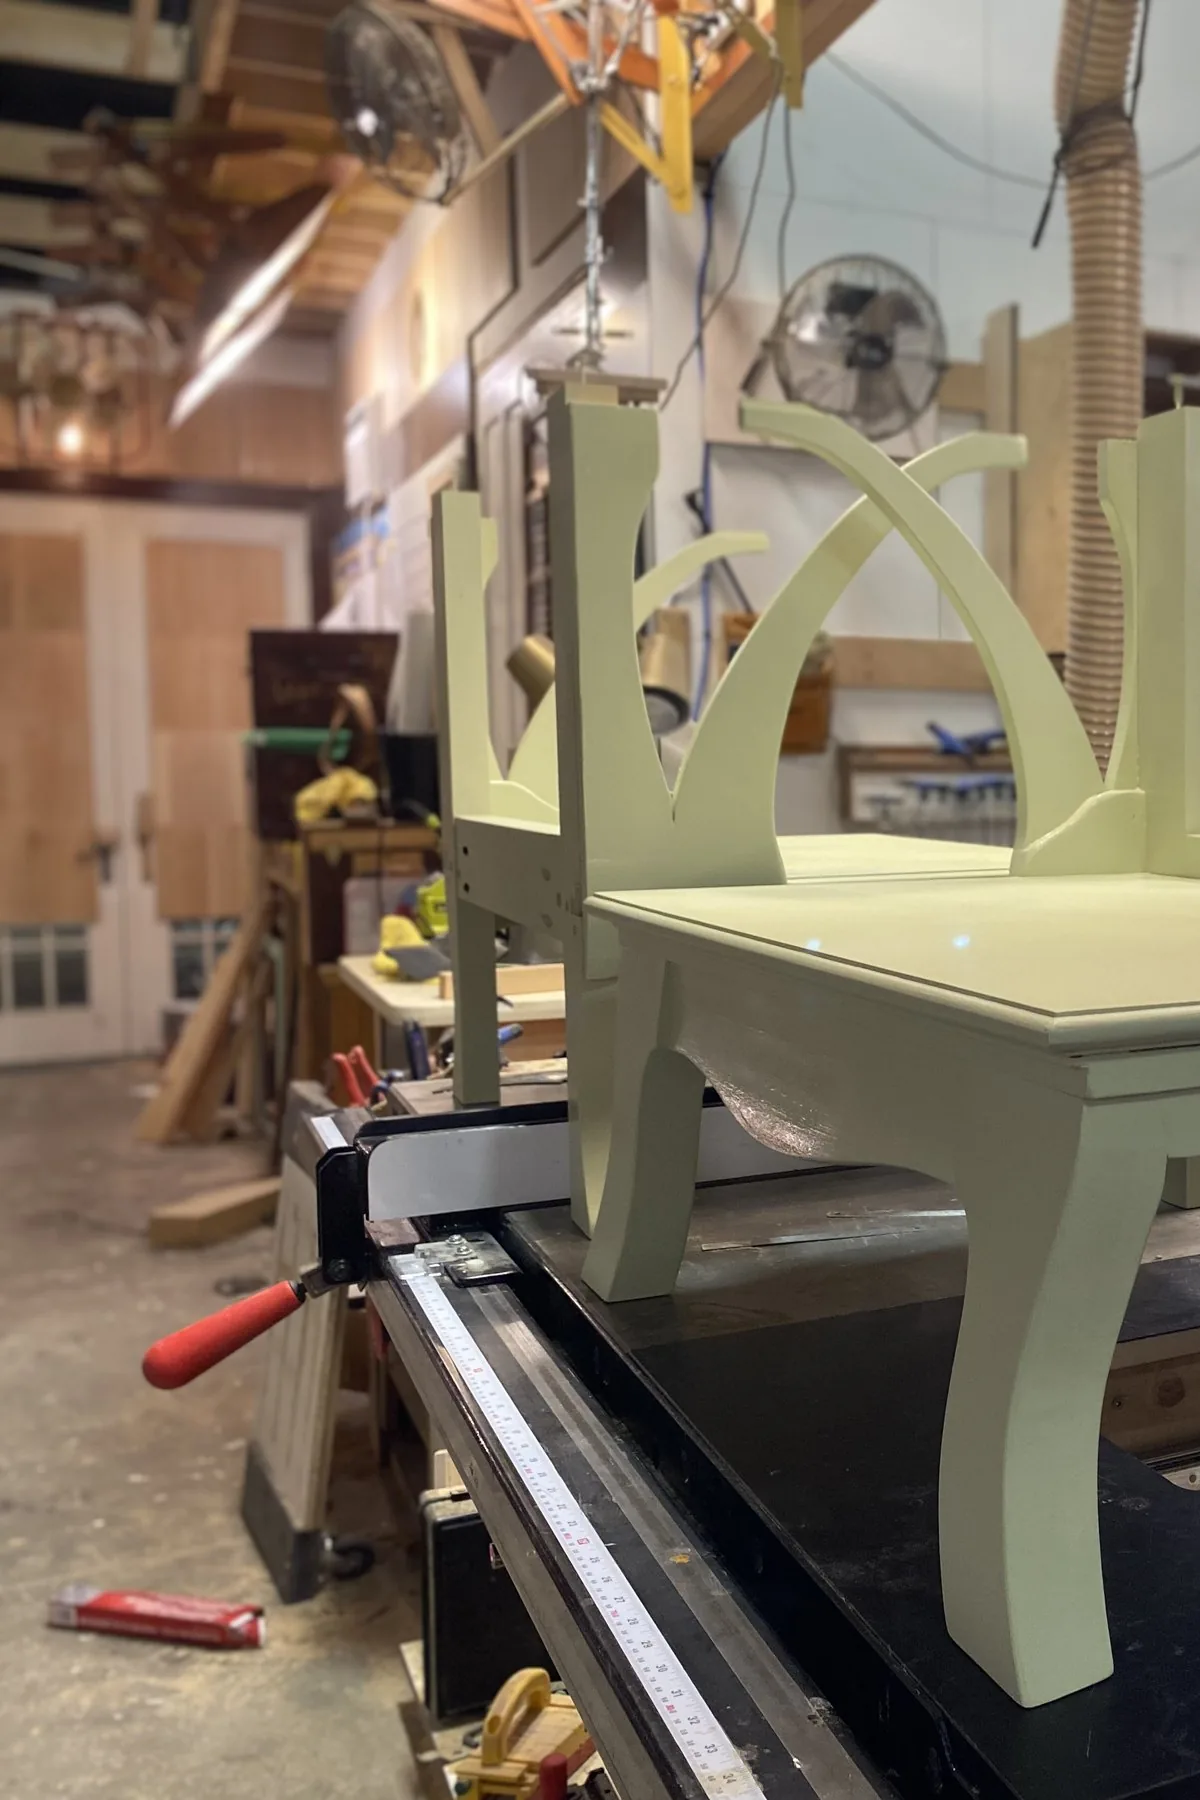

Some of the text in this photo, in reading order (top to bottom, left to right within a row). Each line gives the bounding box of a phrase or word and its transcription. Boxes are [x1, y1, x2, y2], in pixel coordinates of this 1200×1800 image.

[656, 1664, 668, 1673] 30
[671, 1689, 684, 1698] 31
[687, 1716, 700, 1725] 32
[704, 1743, 718, 1754] 33
